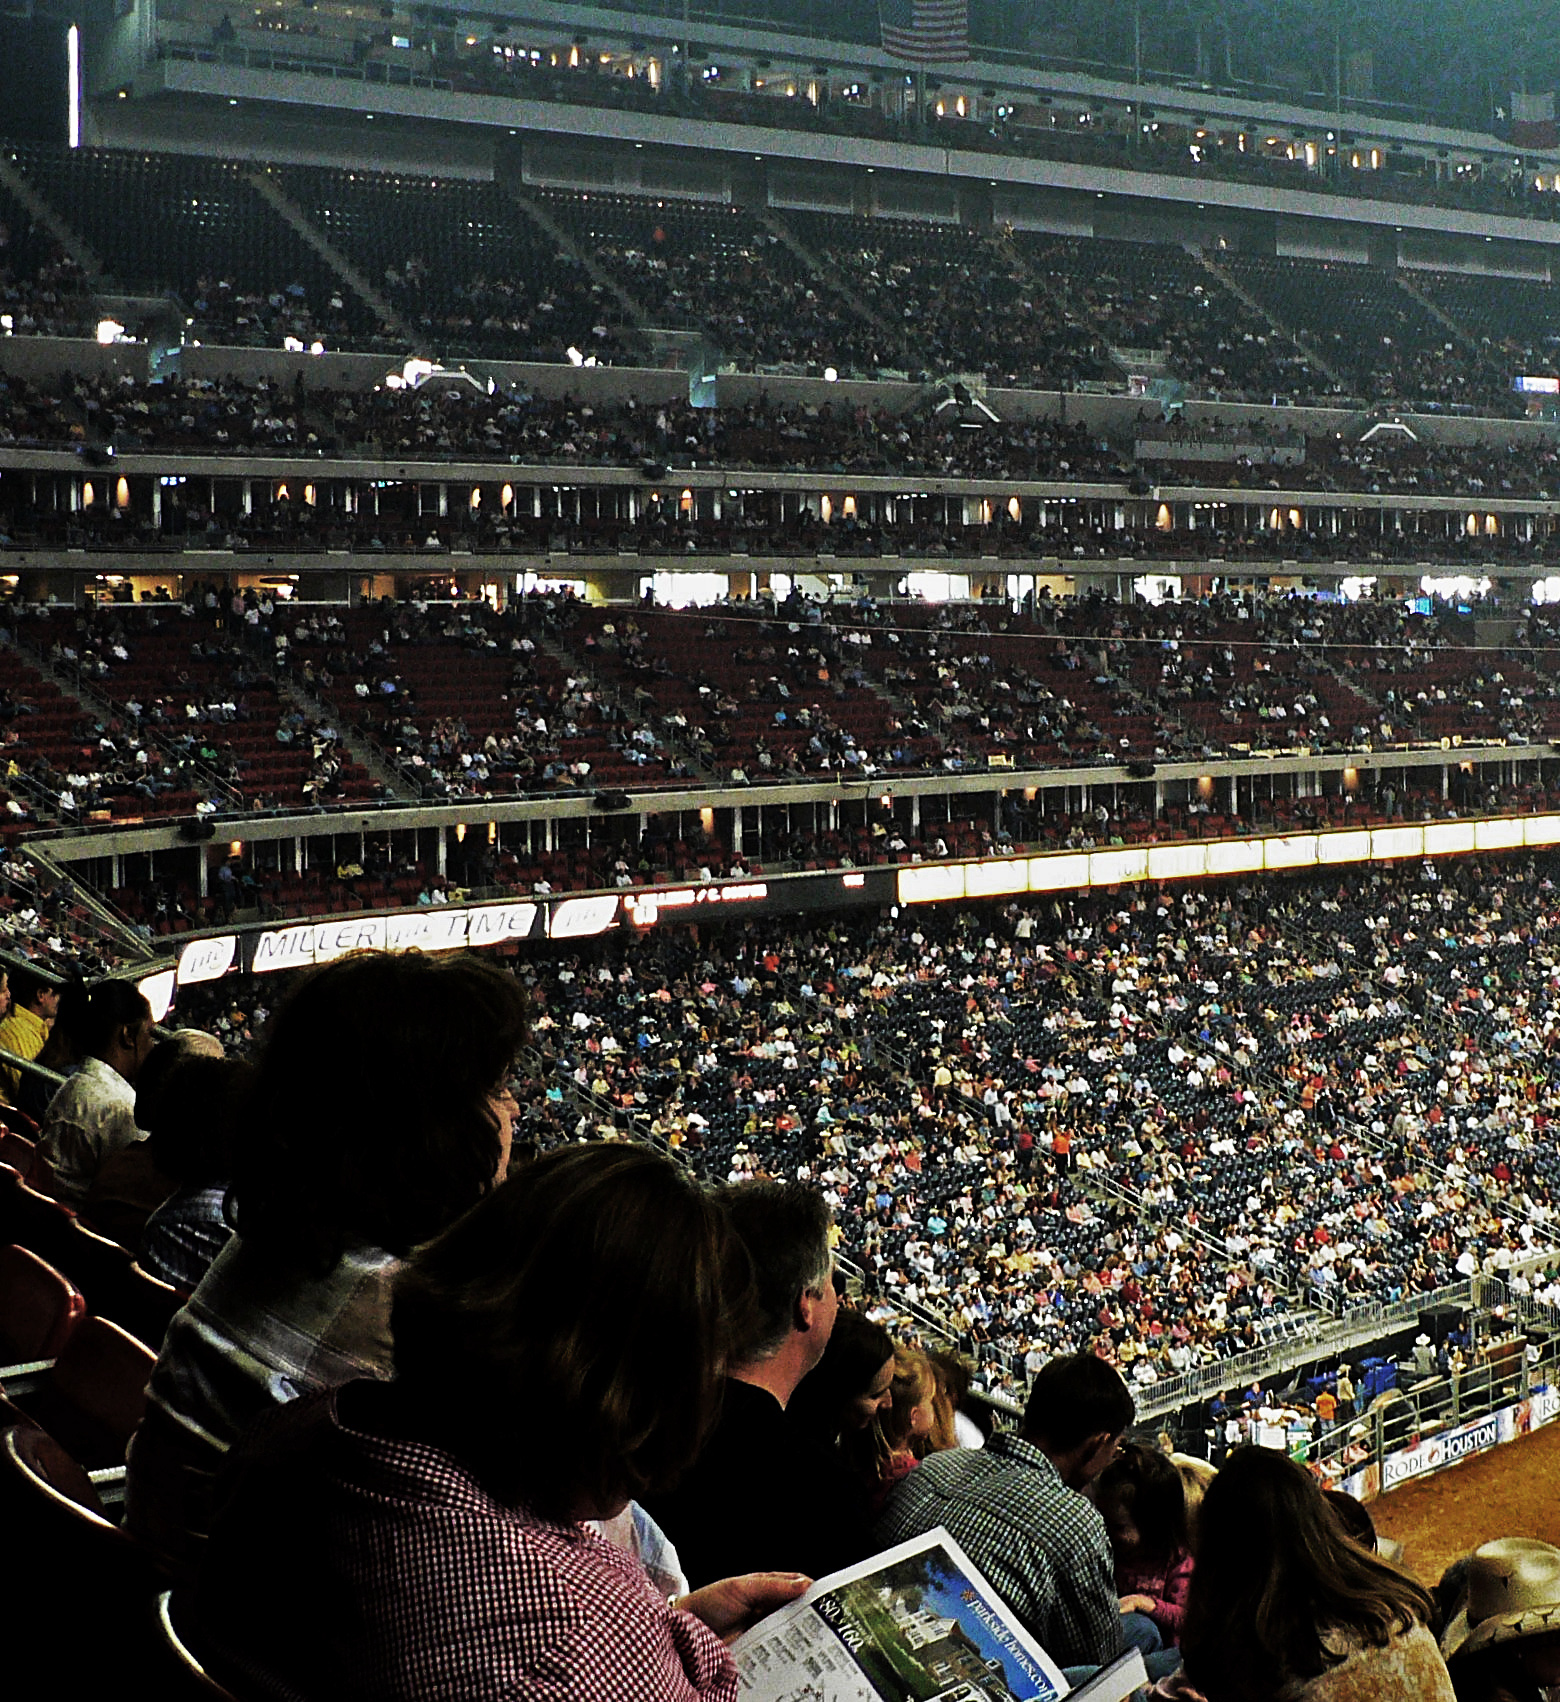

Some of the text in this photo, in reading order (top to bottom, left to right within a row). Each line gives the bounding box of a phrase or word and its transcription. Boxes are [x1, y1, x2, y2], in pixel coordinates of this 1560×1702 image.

[259, 923, 378, 958] MILLER
[447, 907, 530, 937] TIME
[1441, 1423, 1497, 1462] HOUSTON
